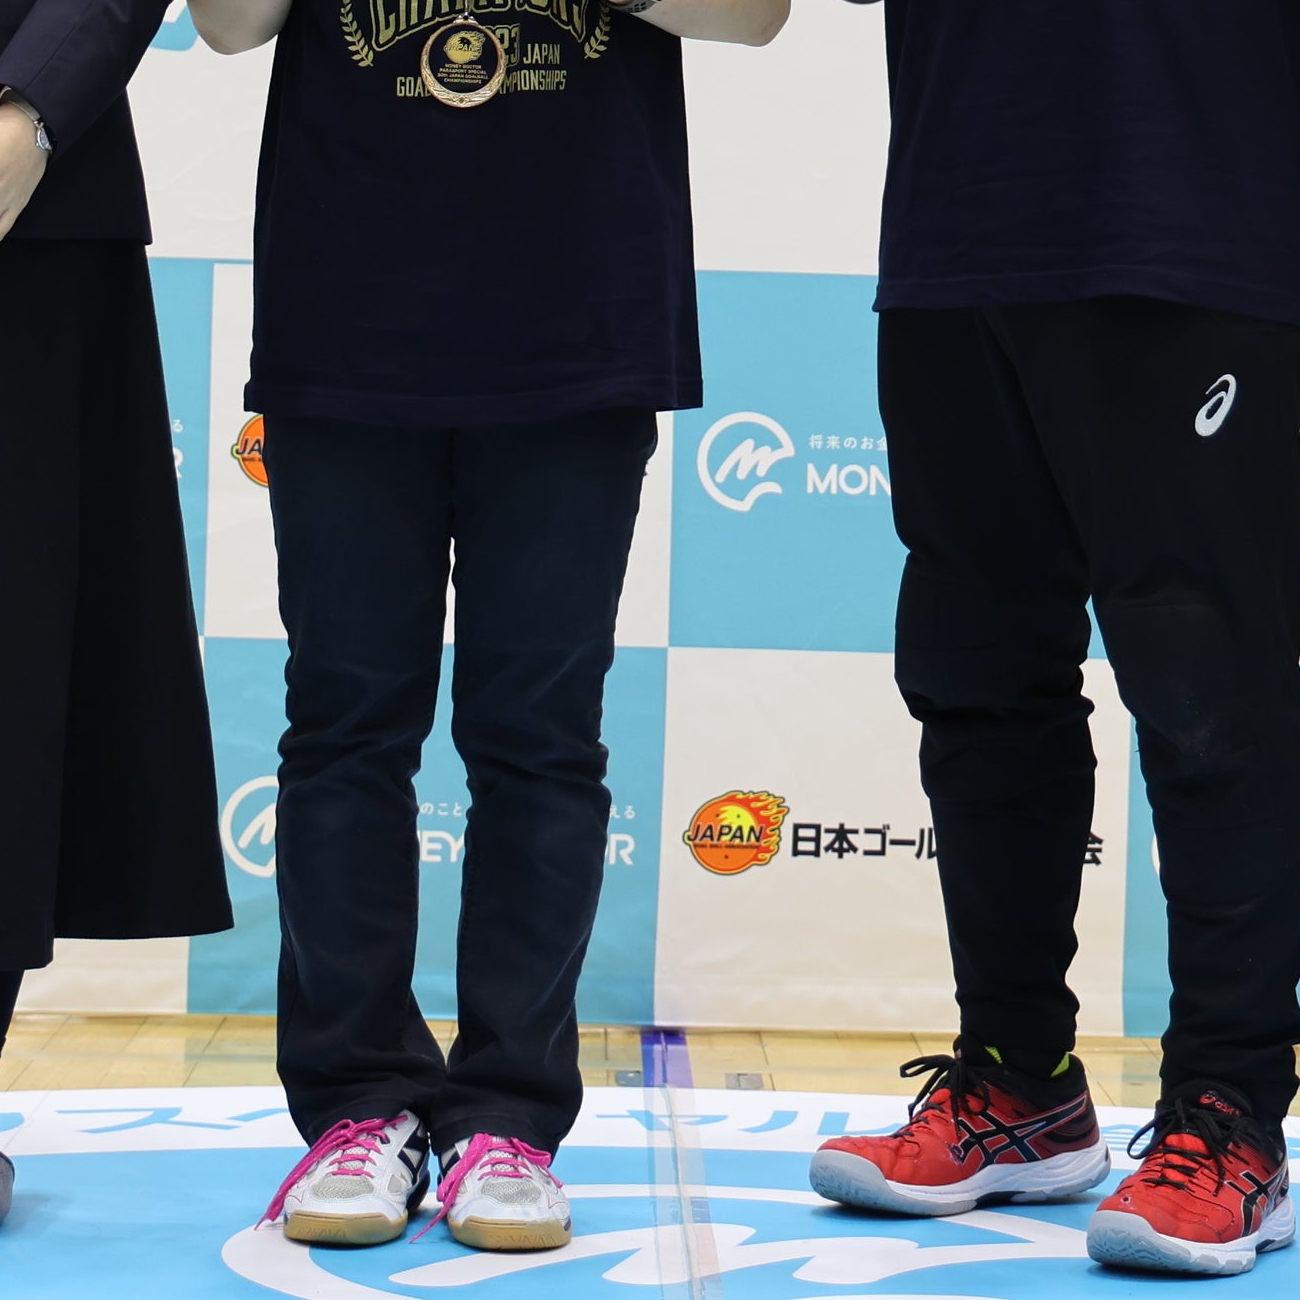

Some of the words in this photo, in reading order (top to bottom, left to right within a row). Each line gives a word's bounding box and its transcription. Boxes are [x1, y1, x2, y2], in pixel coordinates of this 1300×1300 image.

[523, 43, 561, 65] JAPAN
[500, 69, 568, 95] MPIONSHIPS
[805, 462, 892, 497] MON
[688, 822, 765, 845] JAPAN
[791, 823, 938, 860] 日本ゴール
